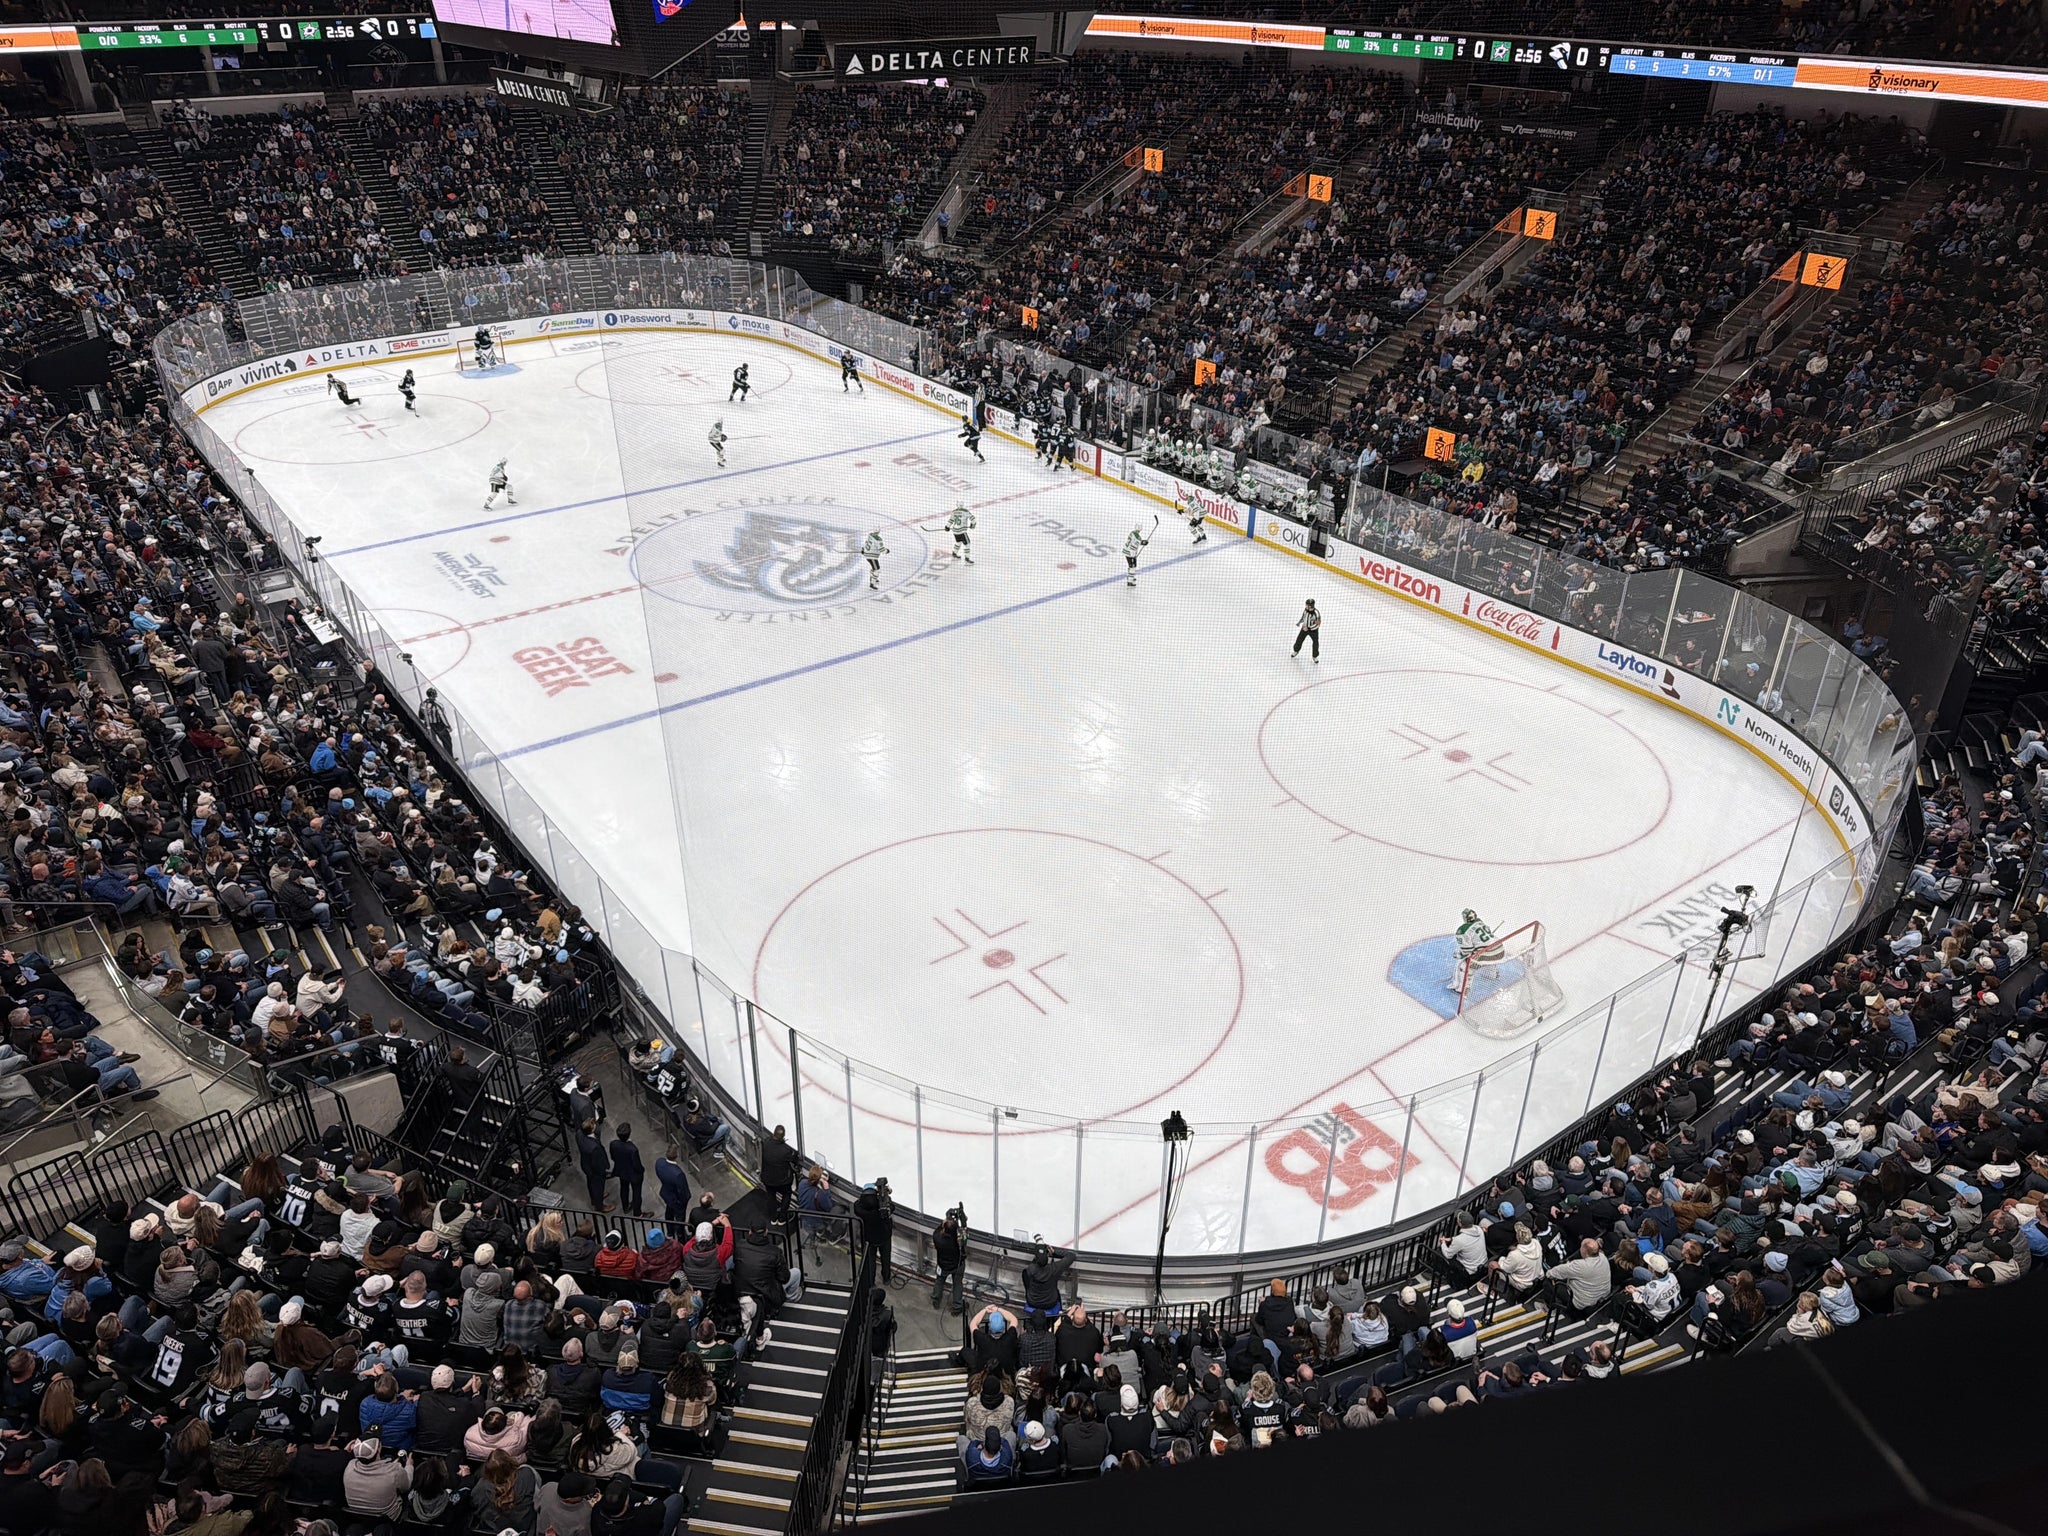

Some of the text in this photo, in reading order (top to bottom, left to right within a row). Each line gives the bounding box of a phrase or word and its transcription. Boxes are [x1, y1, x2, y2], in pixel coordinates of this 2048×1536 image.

[261, 30, 268, 39] 5
[279, 23, 292, 39] 0
[326, 26, 354, 38] 2:56
[387, 20, 398, 36] 0
[1146, 24, 1176, 34] visionary
[99, 36, 118, 46] 0/0
[138, 34, 162, 44] 33%
[179, 34, 187, 43] 6
[208, 33, 216, 42] 5
[232, 32, 245, 41] 13
[1257, 31, 1286, 42] visionary
[1336, 39, 1350, 49] 0/0
[1363, 41, 1380, 51] 33%
[1392, 43, 1398, 52] 6
[1414, 44, 1421, 54] 5
[1474, 40, 1485, 58] 0
[1434, 46, 1444, 56] 13
[1457, 47, 1464, 56] 5
[1515, 49, 1542, 63] 2:56
[1576, 48, 1589, 66] 0
[872, 46, 1029, 72] DELTA CENTER
[1599, 56, 1607, 66] 9
[1710, 54, 1736, 62] FACEOFFS
[1624, 60, 1636, 70] 16
[1652, 62, 1659, 72] 5
[1682, 64, 1689, 74] 3
[1708, 65, 1732, 78] 67%
[1754, 69, 1773, 80] 0/1
[1883, 74, 1940, 92] visionary
[503, 80, 570, 107] DELTA CENTER
[1415, 110, 1481, 132] HealthEquity
[551, 318, 594, 327] SameDay
[620, 314, 671, 323] 1Password
[742, 318, 770, 331] moxie
[392, 337, 446, 350] SME STEEL
[322, 344, 378, 362] DELTA
[240, 360, 283, 385] vivint
[879, 366, 915, 392] Trucordia
[930, 386, 968, 413] Ken Garff
[1195, 488, 1239, 524] Smith's
[616, 494, 836, 544] DELTA CENTER
[432, 551, 470, 582] AMERICA
[465, 579, 496, 599] FIRST
[1359, 556, 1441, 604] verizon
[714, 604, 857, 622] CENTER
[1476, 600, 1546, 642] Coca-Cola
[556, 636, 635, 679] SEAT
[1598, 642, 1657, 679] Layton
[512, 646, 590, 698] GEEK
[1744, 718, 1813, 776] Nomi Health
[1641, 882, 1737, 938] BANK
[658, 1074, 674, 1096] 92
[152, 1344, 182, 1387] 19
[1254, 1415, 1280, 1426] CROUSE
